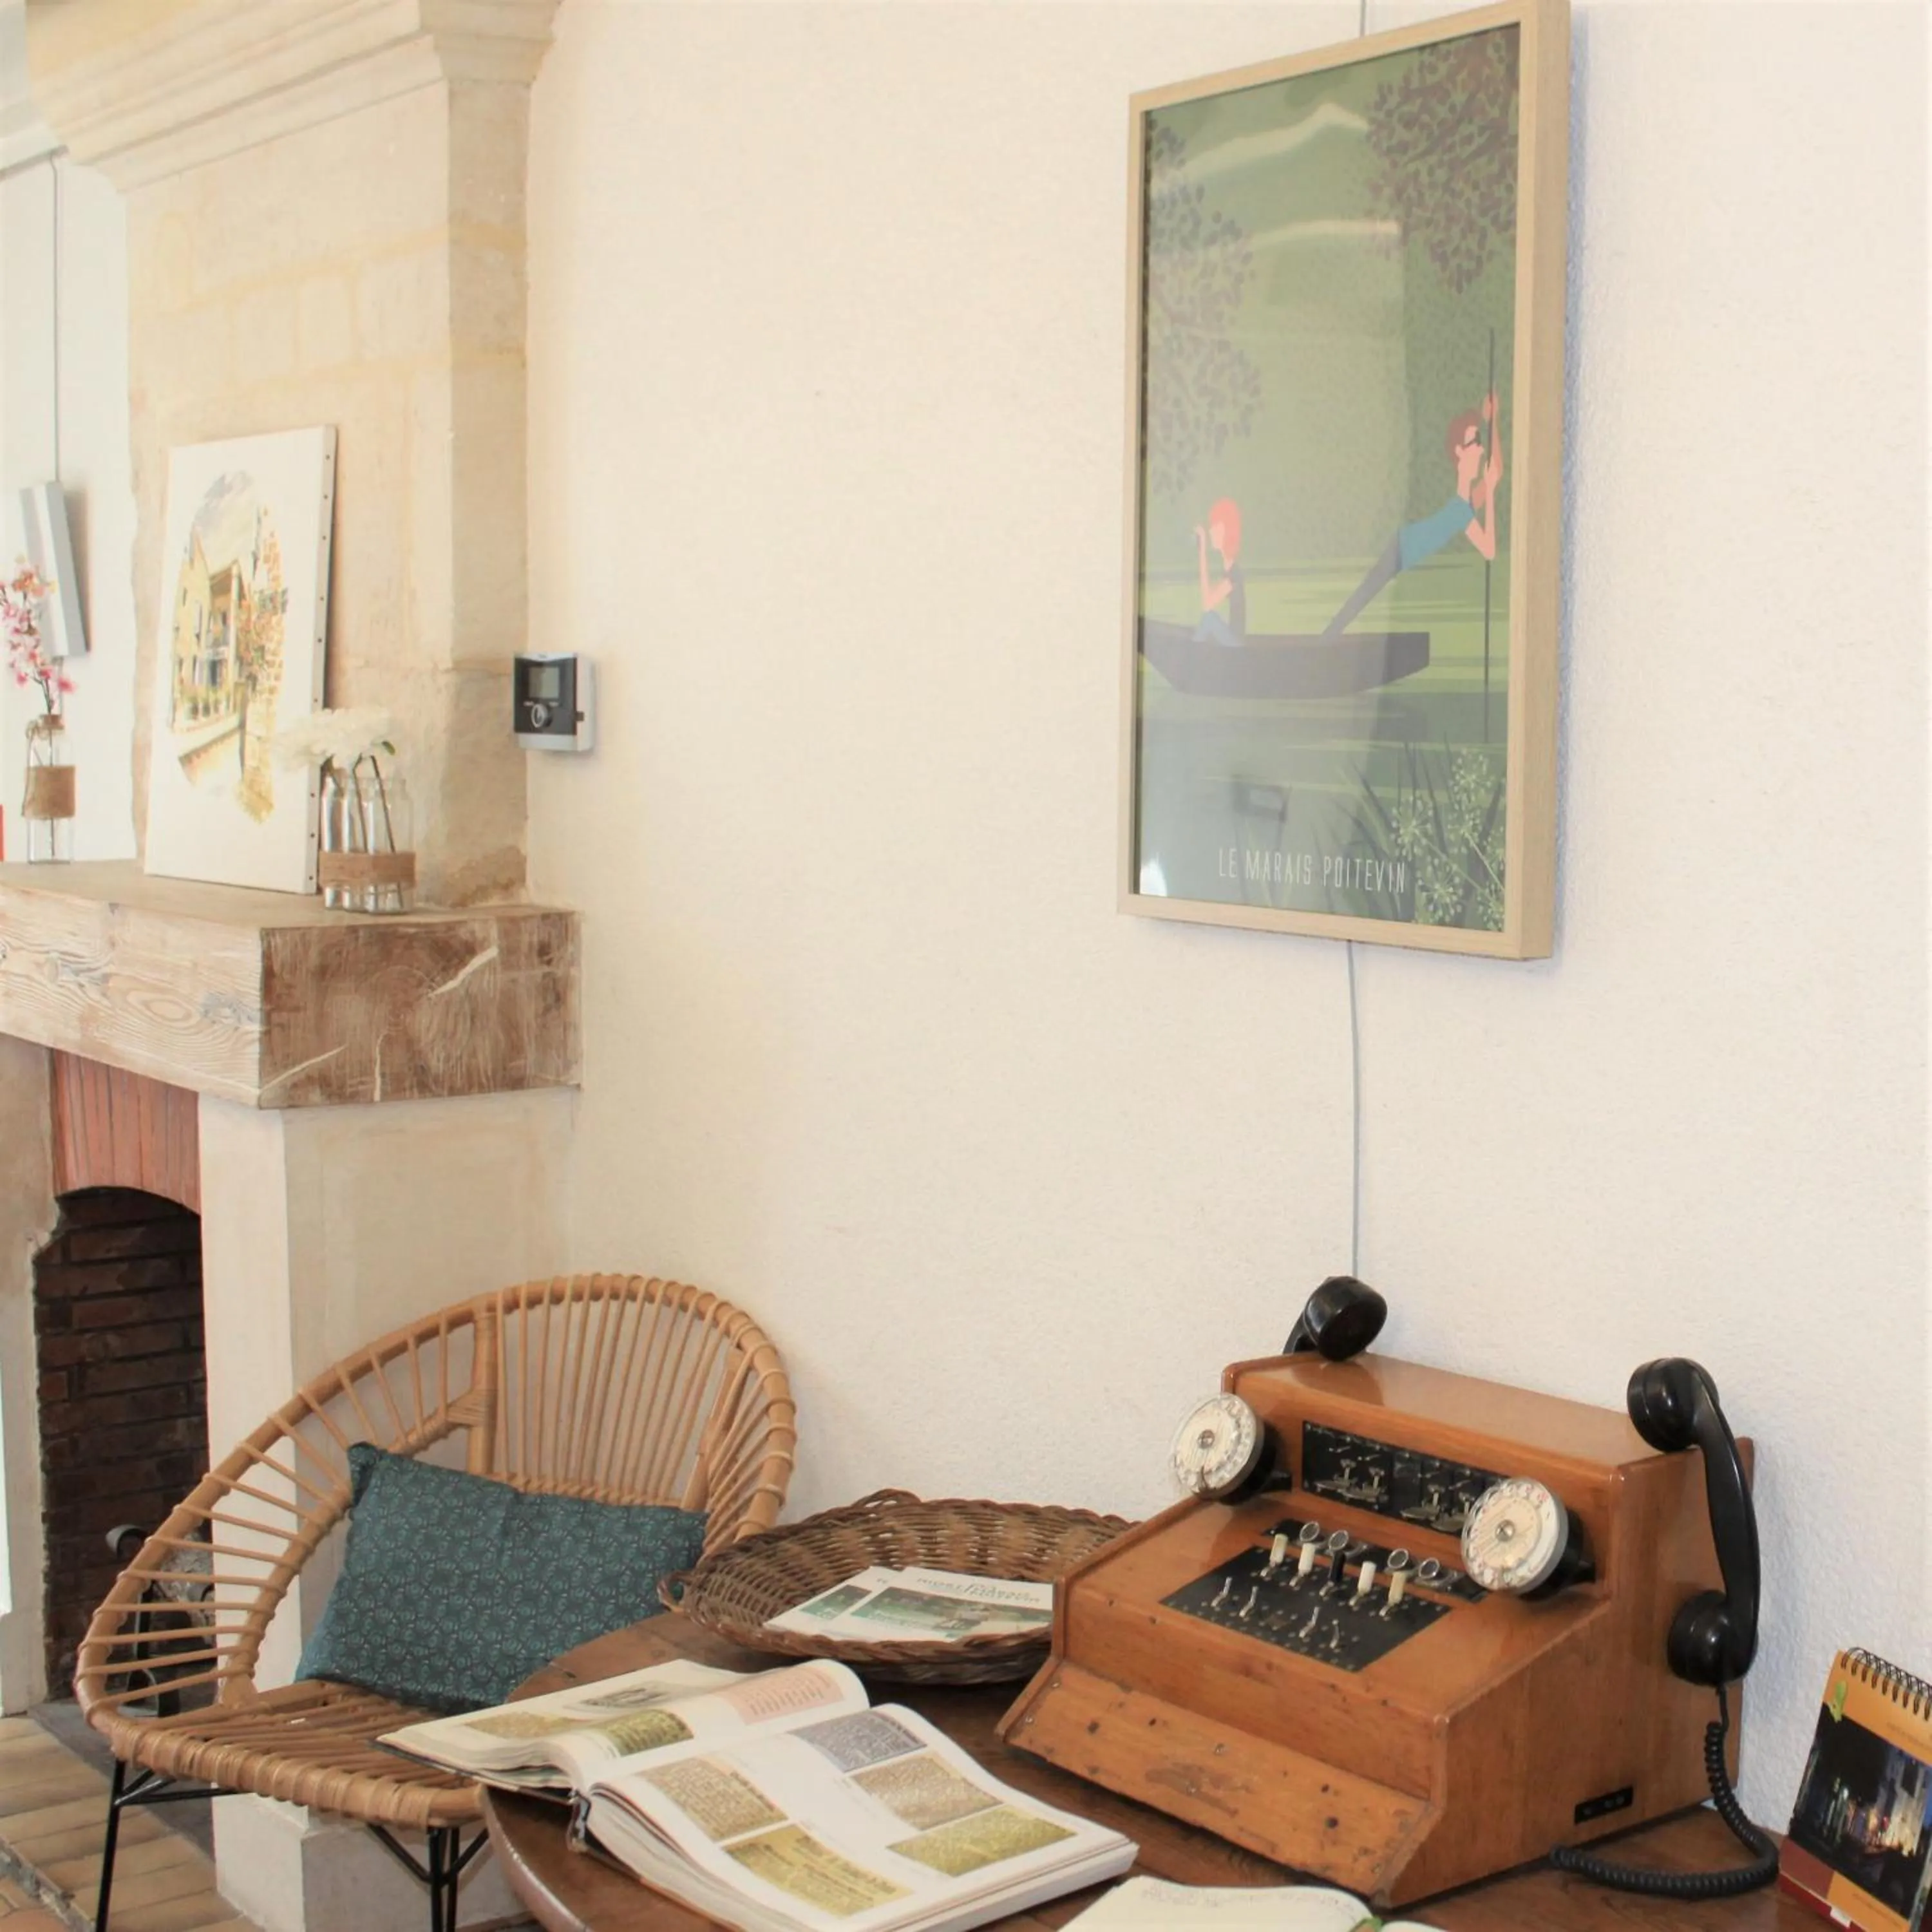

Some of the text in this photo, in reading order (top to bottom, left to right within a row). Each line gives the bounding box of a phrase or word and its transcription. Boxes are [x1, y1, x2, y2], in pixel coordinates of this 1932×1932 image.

[1219, 848, 1405, 893] LE MARAIS POITEVIN
